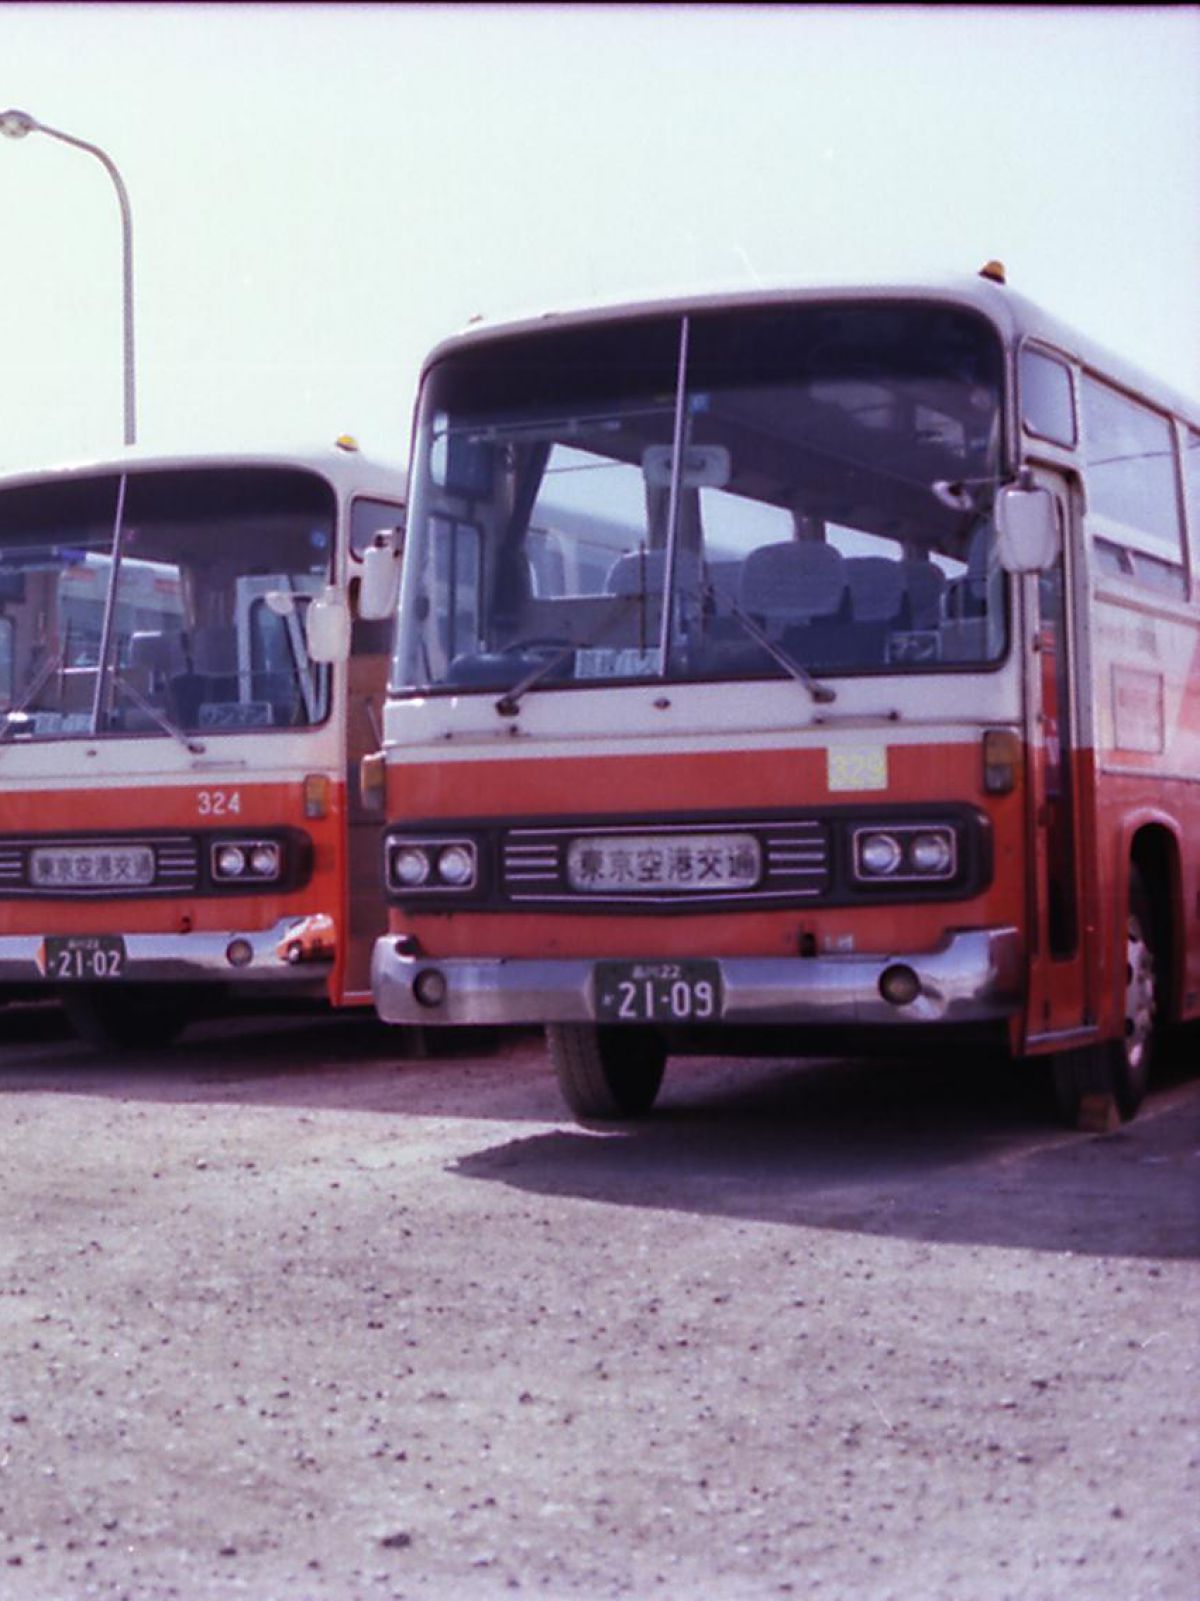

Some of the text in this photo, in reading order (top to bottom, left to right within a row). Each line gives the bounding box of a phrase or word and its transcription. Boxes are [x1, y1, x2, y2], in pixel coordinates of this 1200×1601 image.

[197, 791, 240, 815] 324
[580, 846, 758, 882] 東京空港交通
[59, 950, 121, 976] 21-02
[619, 981, 713, 1017] 21-09
